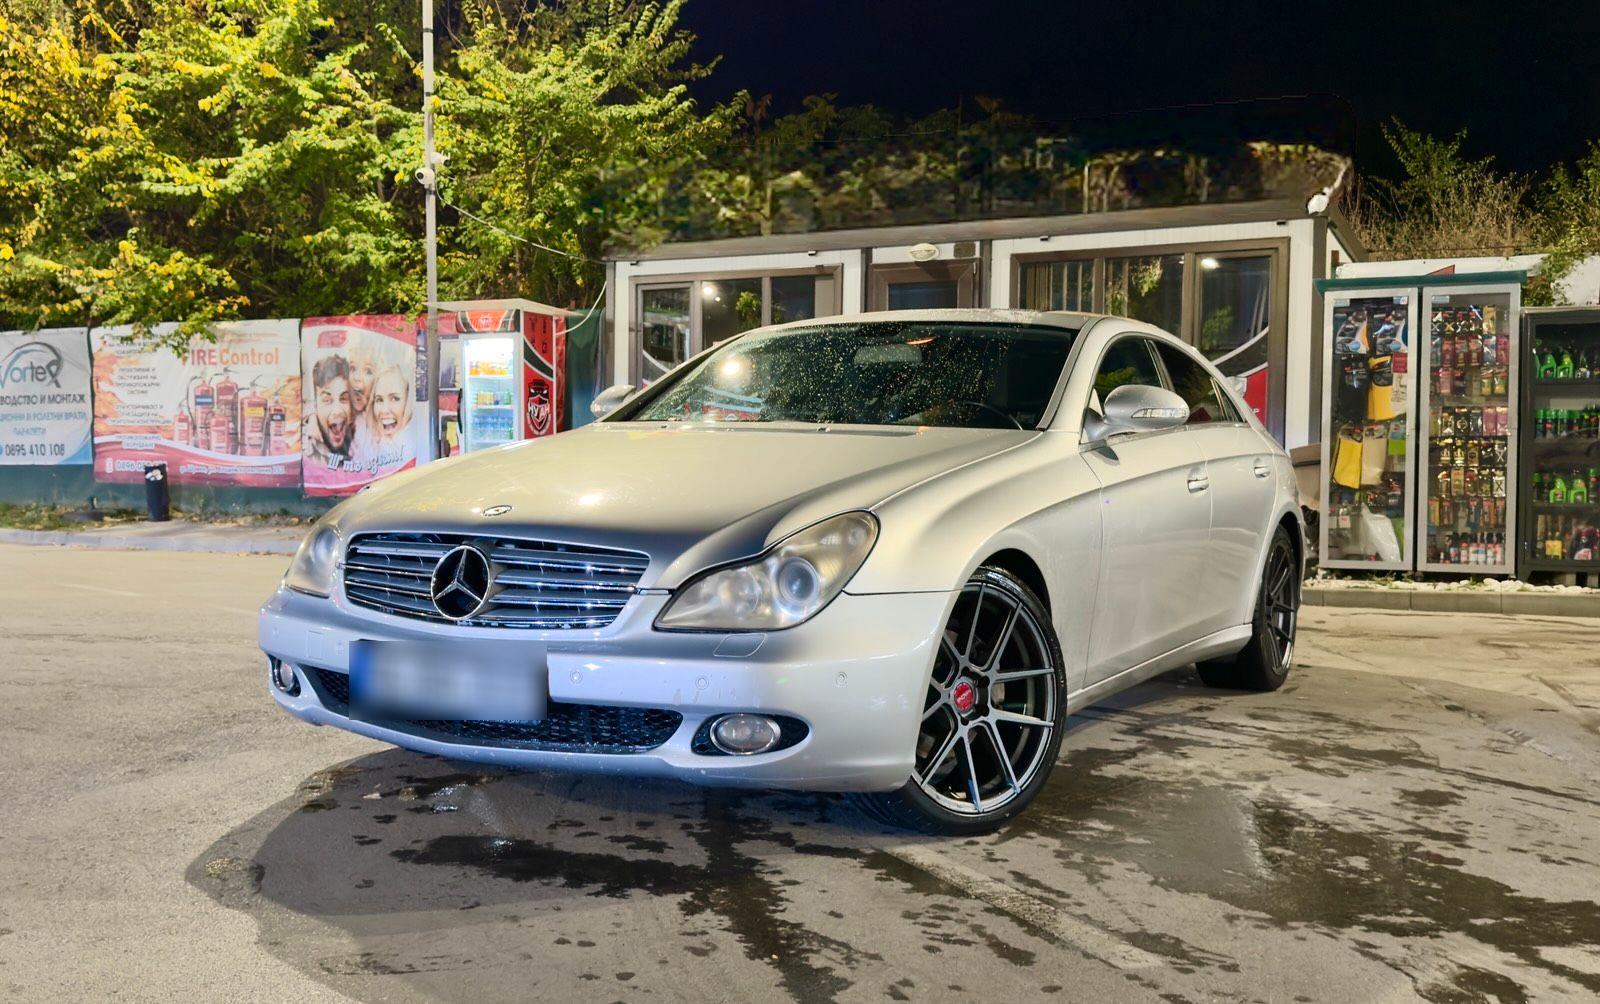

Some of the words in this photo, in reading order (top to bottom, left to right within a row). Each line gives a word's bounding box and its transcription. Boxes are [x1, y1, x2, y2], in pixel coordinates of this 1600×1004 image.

[40, 394, 46, 406] И
[48, 392, 86, 406] МОНТАЖ
[30, 443, 46, 456] 410
